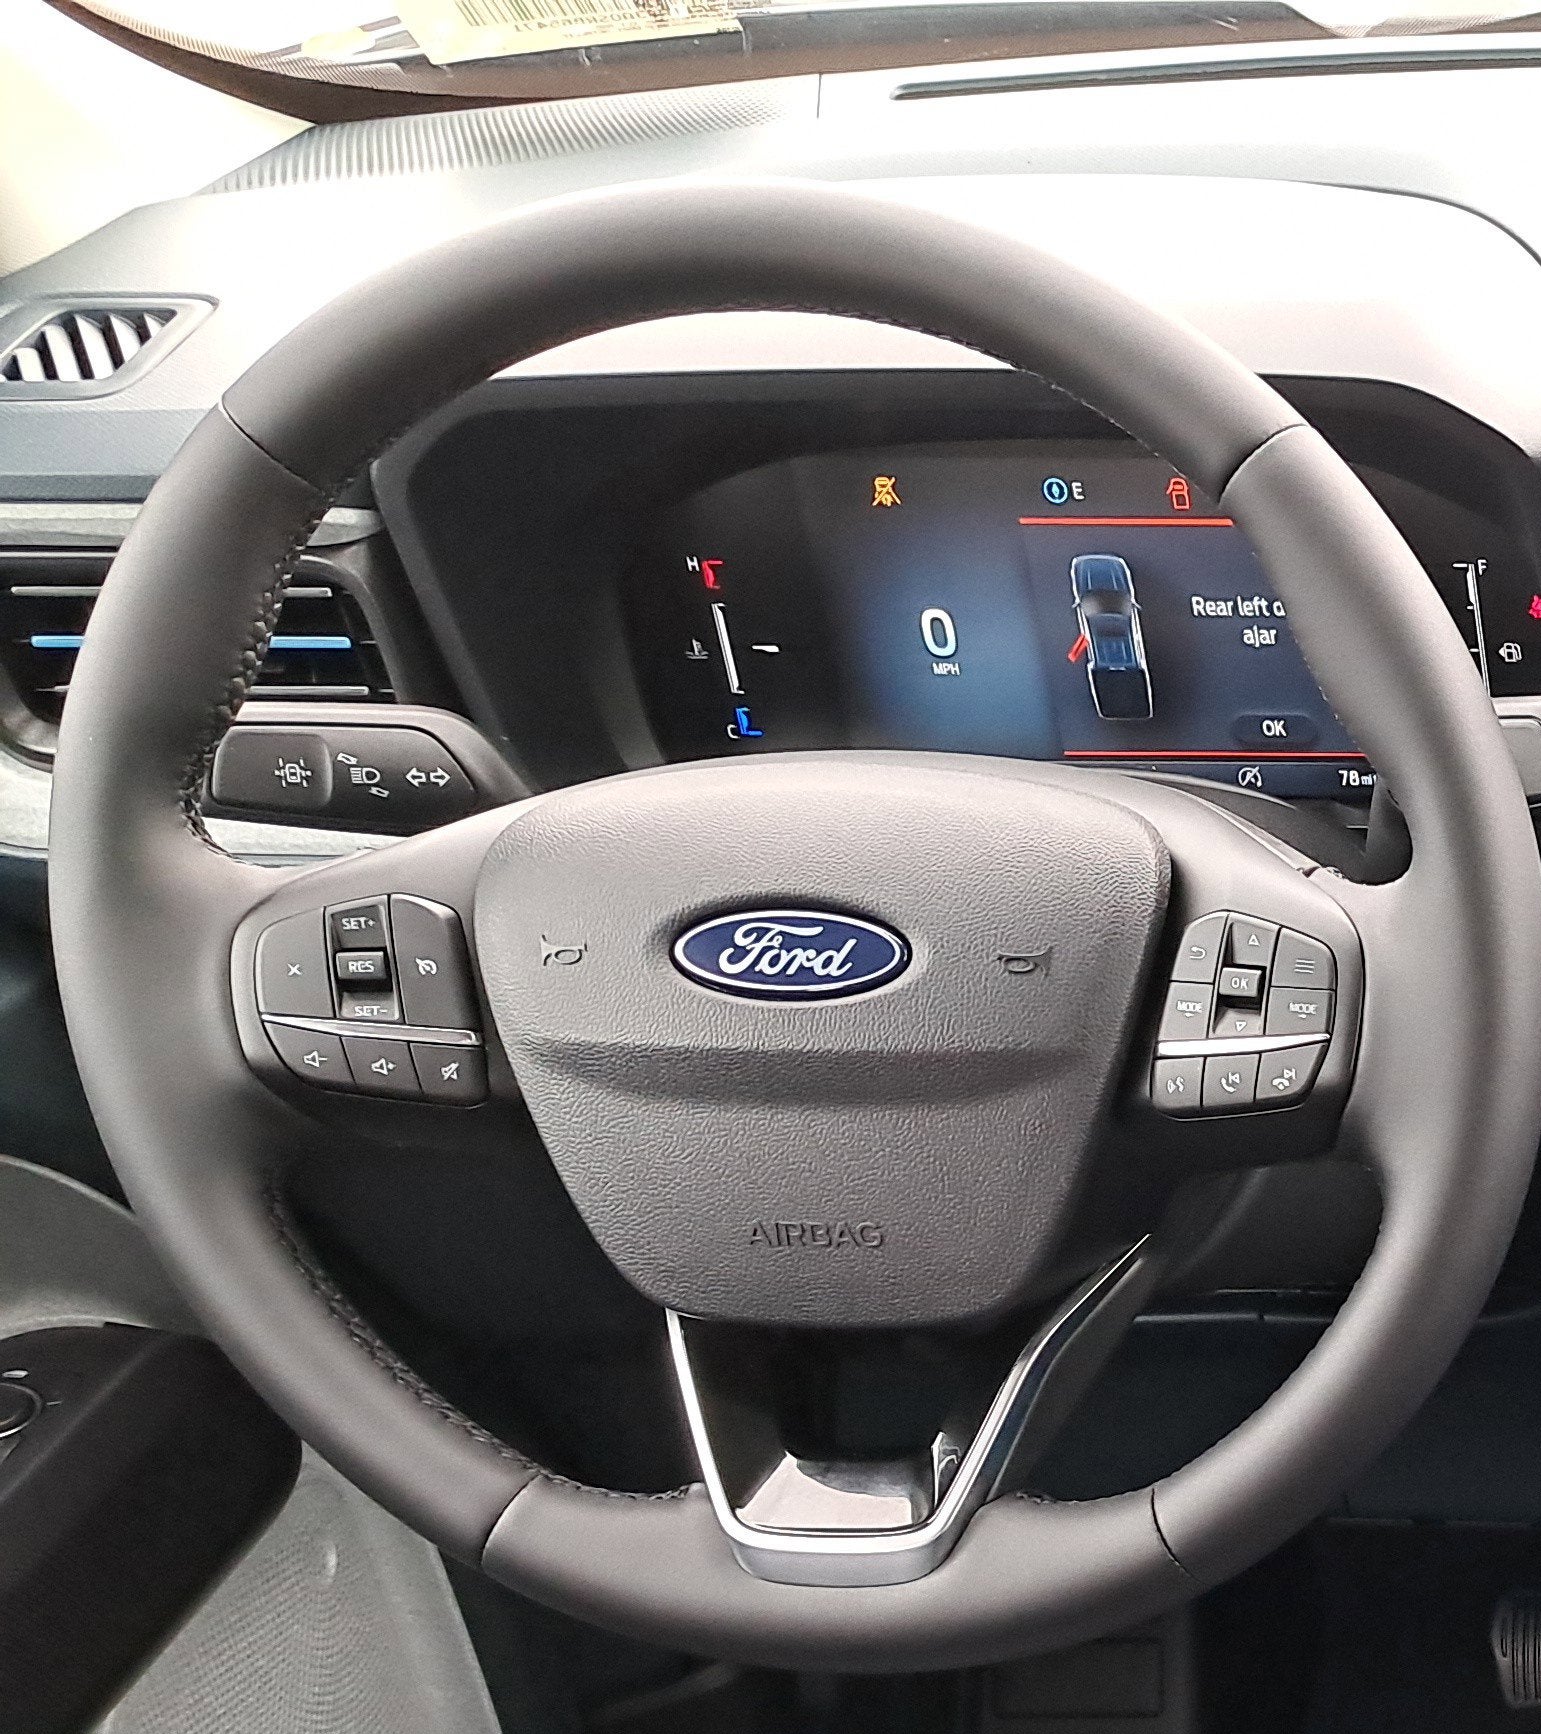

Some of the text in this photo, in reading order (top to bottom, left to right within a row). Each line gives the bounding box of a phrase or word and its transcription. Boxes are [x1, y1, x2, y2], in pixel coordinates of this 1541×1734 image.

[1072, 482, 1084, 500] E
[686, 556, 700, 571] H
[1477, 559, 1487, 575] F
[1192, 596, 1232, 617] Rear
[1237, 595, 1267, 617] left
[921, 607, 956, 657] 0
[1242, 626, 1277, 648] ajar
[932, 662, 960, 676] MPH
[727, 724, 740, 739] C
[1262, 720, 1287, 737] OK
[718, 920, 858, 979] Ford
[348, 960, 374, 973] RES
[1231, 977, 1249, 990] OK
[1176, 1001, 1203, 1013] MODE
[1289, 1003, 1318, 1015] MODE
[749, 1219, 885, 1249] AIRBAG
